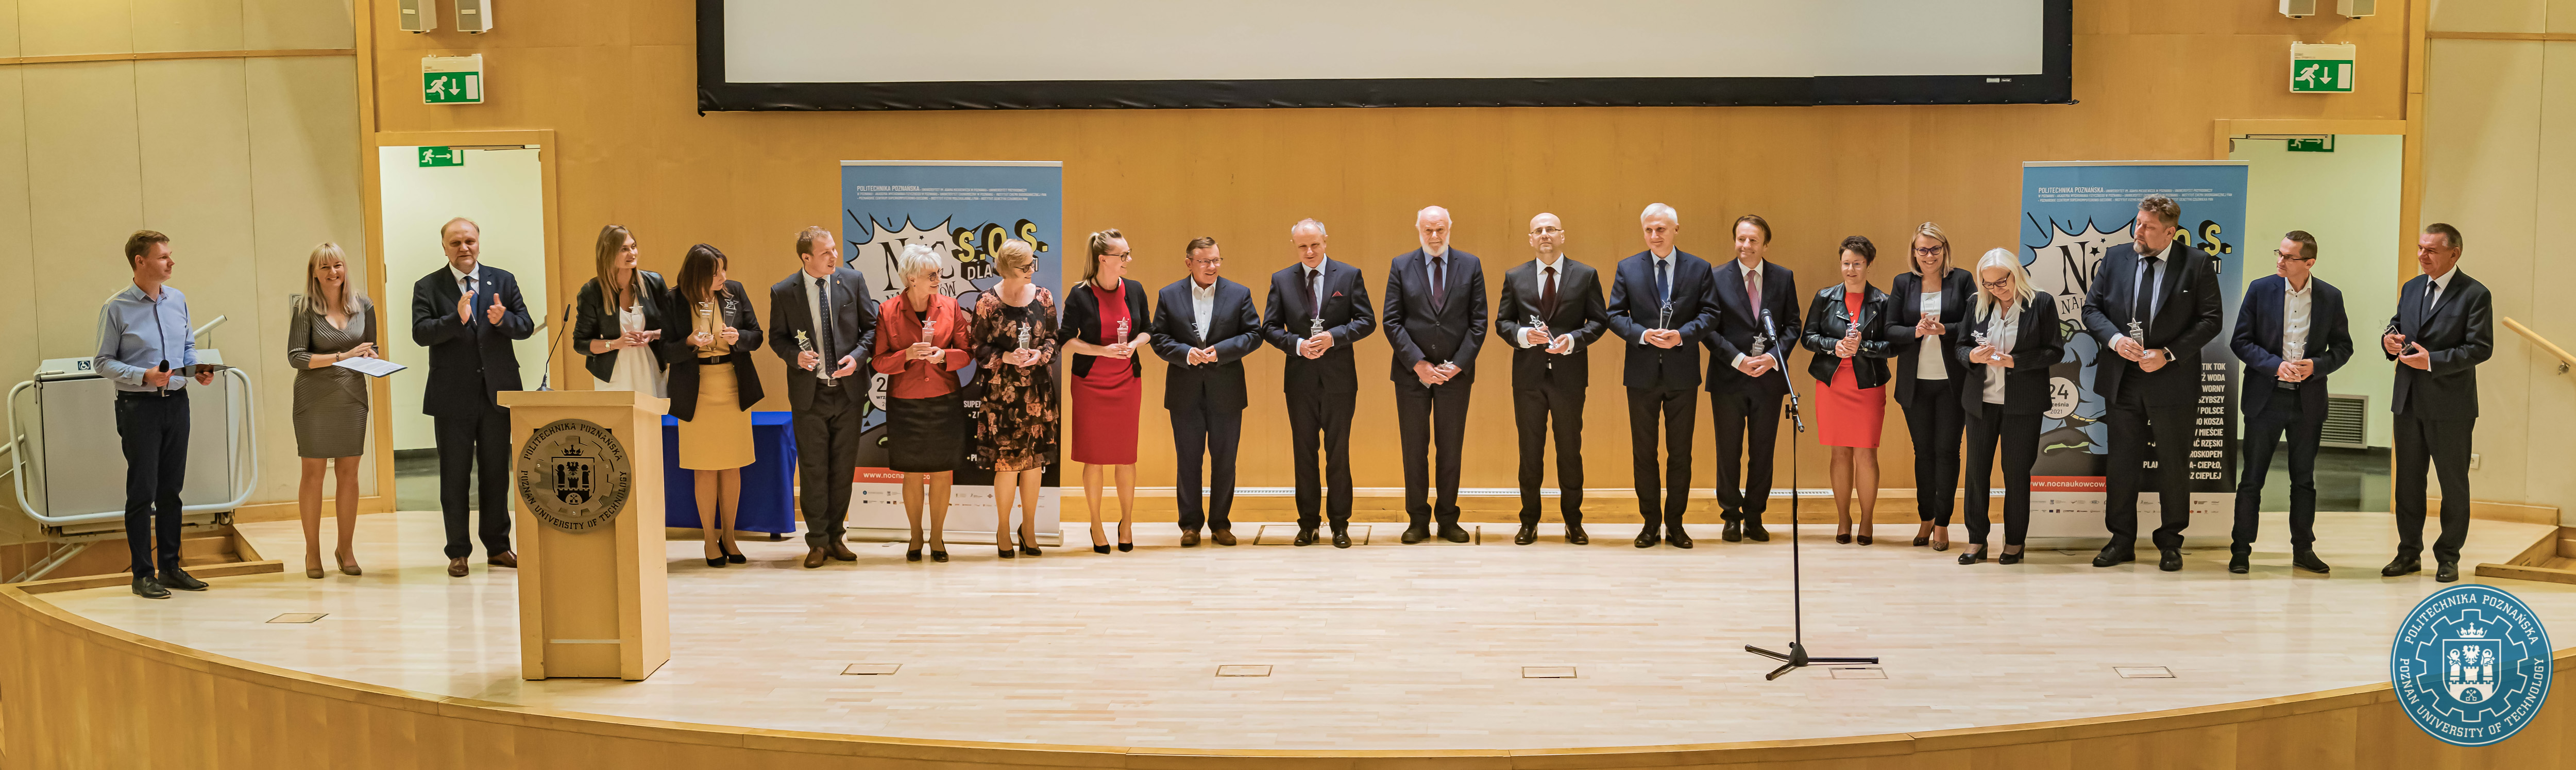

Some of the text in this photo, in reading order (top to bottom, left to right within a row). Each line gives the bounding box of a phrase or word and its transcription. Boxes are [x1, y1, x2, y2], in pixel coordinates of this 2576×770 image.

[967, 264, 993, 280] DLA
[2199, 427, 2224, 436] MIEŚCIE
[523, 423, 623, 462] POLITECHNIKA POZNAŃSKA
[2201, 440, 2223, 448] RZĘSKI
[2197, 461, 2222, 470] CIEPŁO,
[520, 470, 627, 530] POZNAN UNIVERSITY OF TECHNOLOGY
